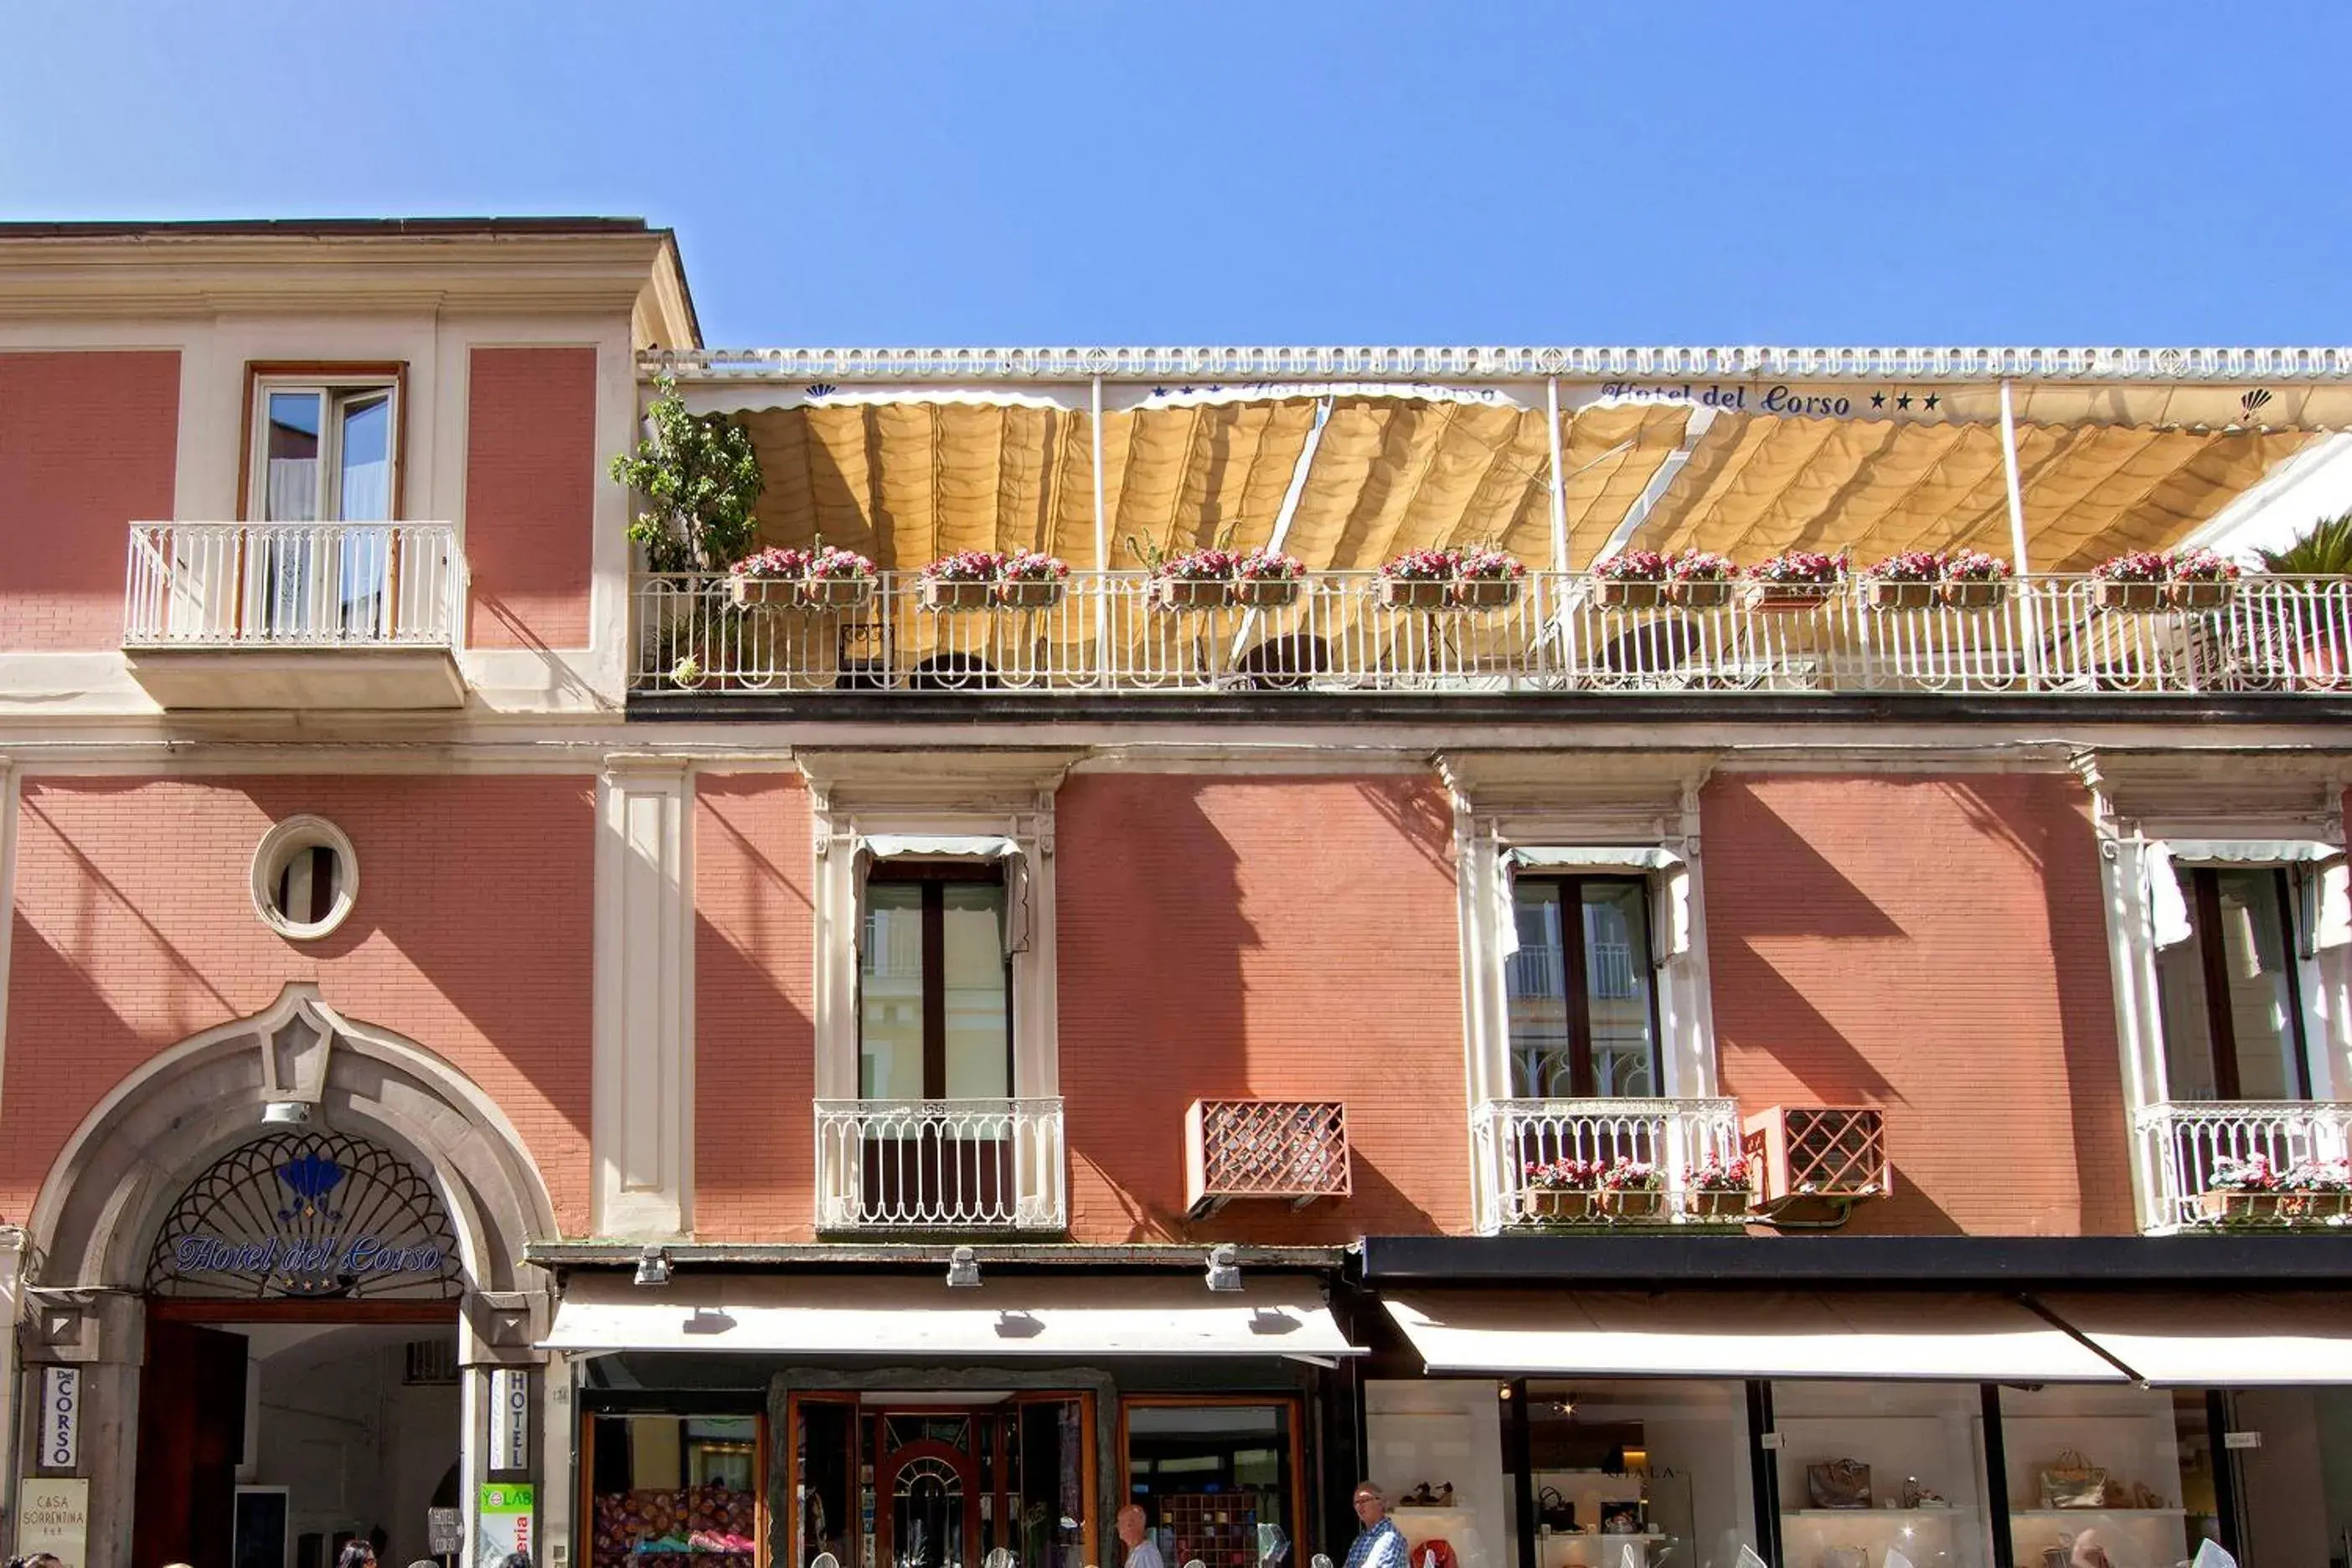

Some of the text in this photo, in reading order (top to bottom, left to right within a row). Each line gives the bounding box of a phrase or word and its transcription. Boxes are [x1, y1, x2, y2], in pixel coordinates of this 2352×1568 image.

[1703, 385, 1746, 409] del
[1761, 384, 1851, 416] Corso
[175, 1235, 442, 1271] Hotel del Corso
[54, 1380, 73, 1464] CORSO
[510, 1371, 525, 1467] HOTEL
[23, 1510, 84, 1525] SORRENTINA
[37, 1495, 69, 1508] CASA
